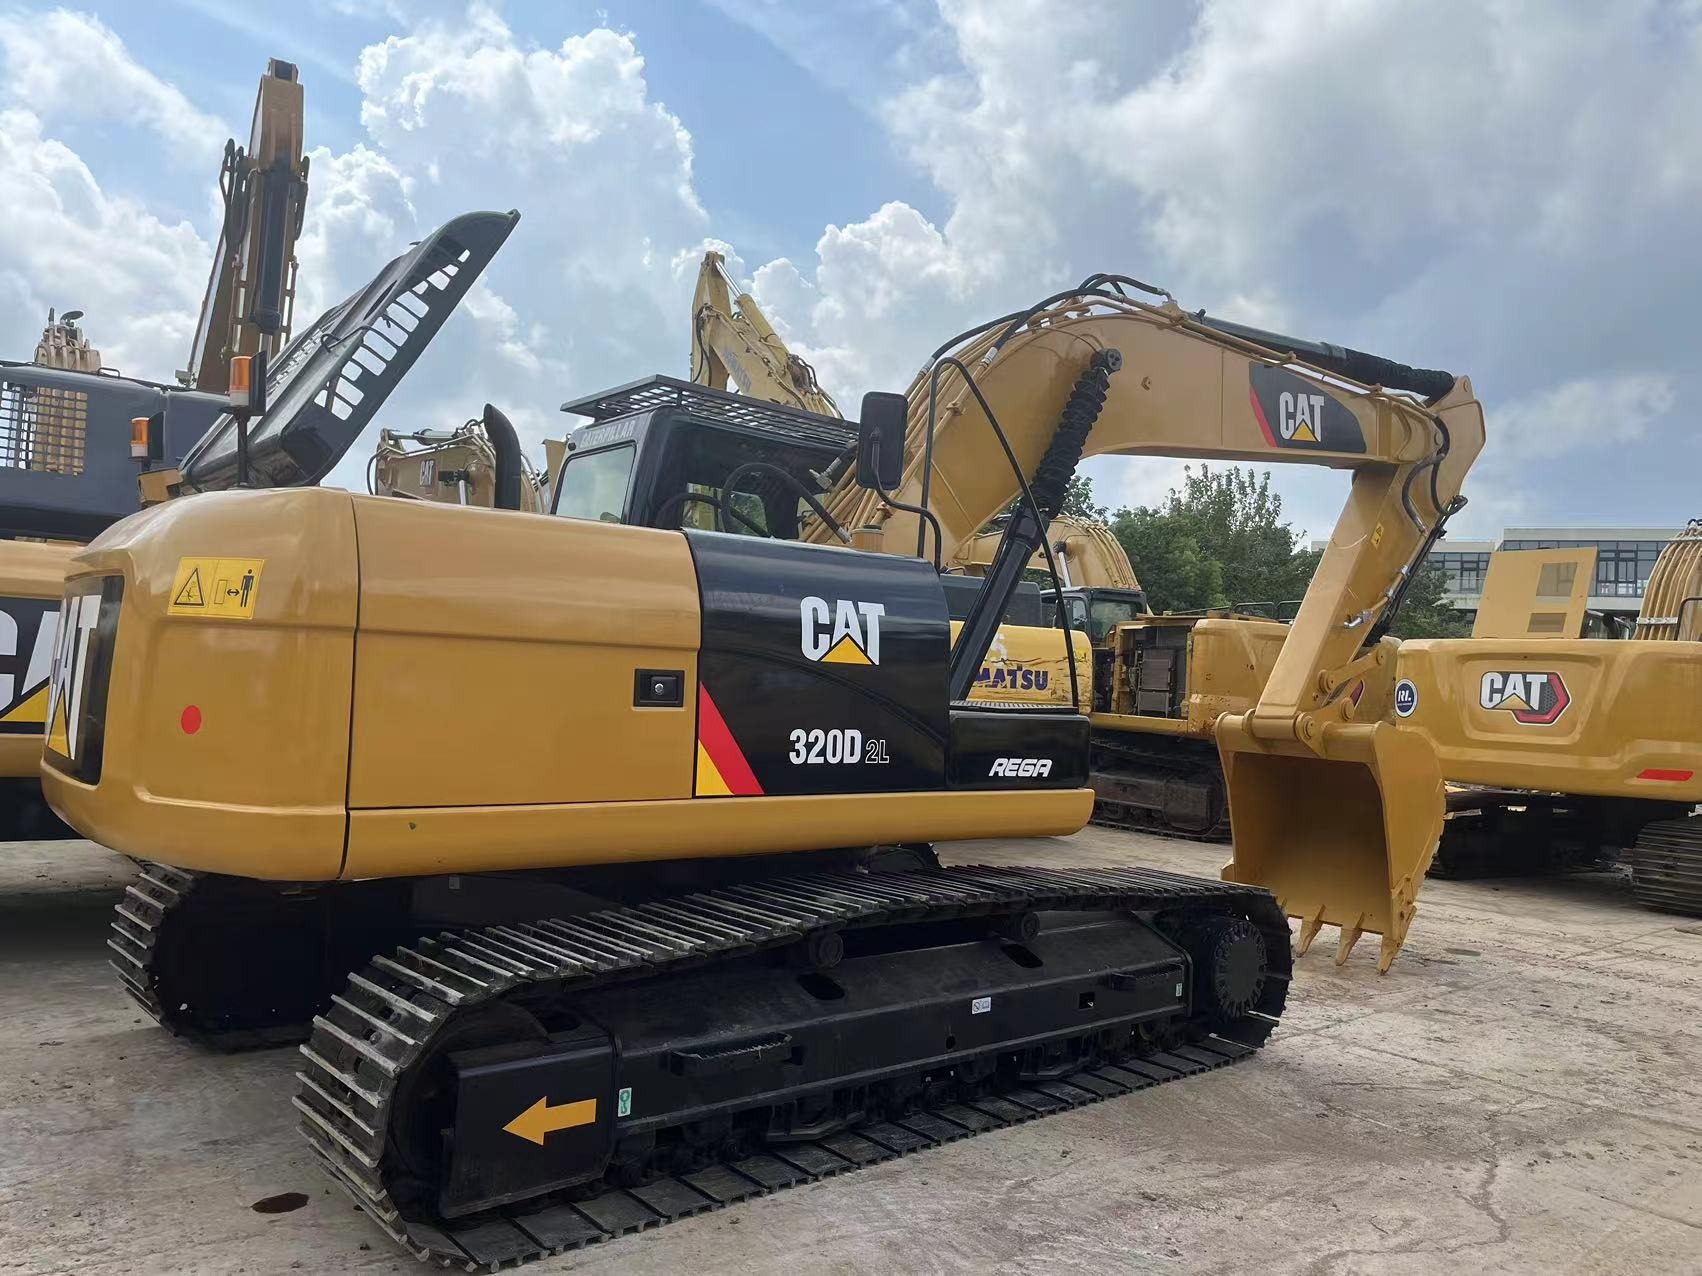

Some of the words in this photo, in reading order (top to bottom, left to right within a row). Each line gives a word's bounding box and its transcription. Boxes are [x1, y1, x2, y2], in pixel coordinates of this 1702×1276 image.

[1279, 391, 1325, 442] CAT
[800, 596, 885, 666] CAT
[974, 667, 1048, 690] MATSU
[1481, 672, 1547, 710] CAT
[789, 728, 862, 764] 320D
[865, 739, 890, 764] 2L
[988, 758, 1053, 777] REGA
